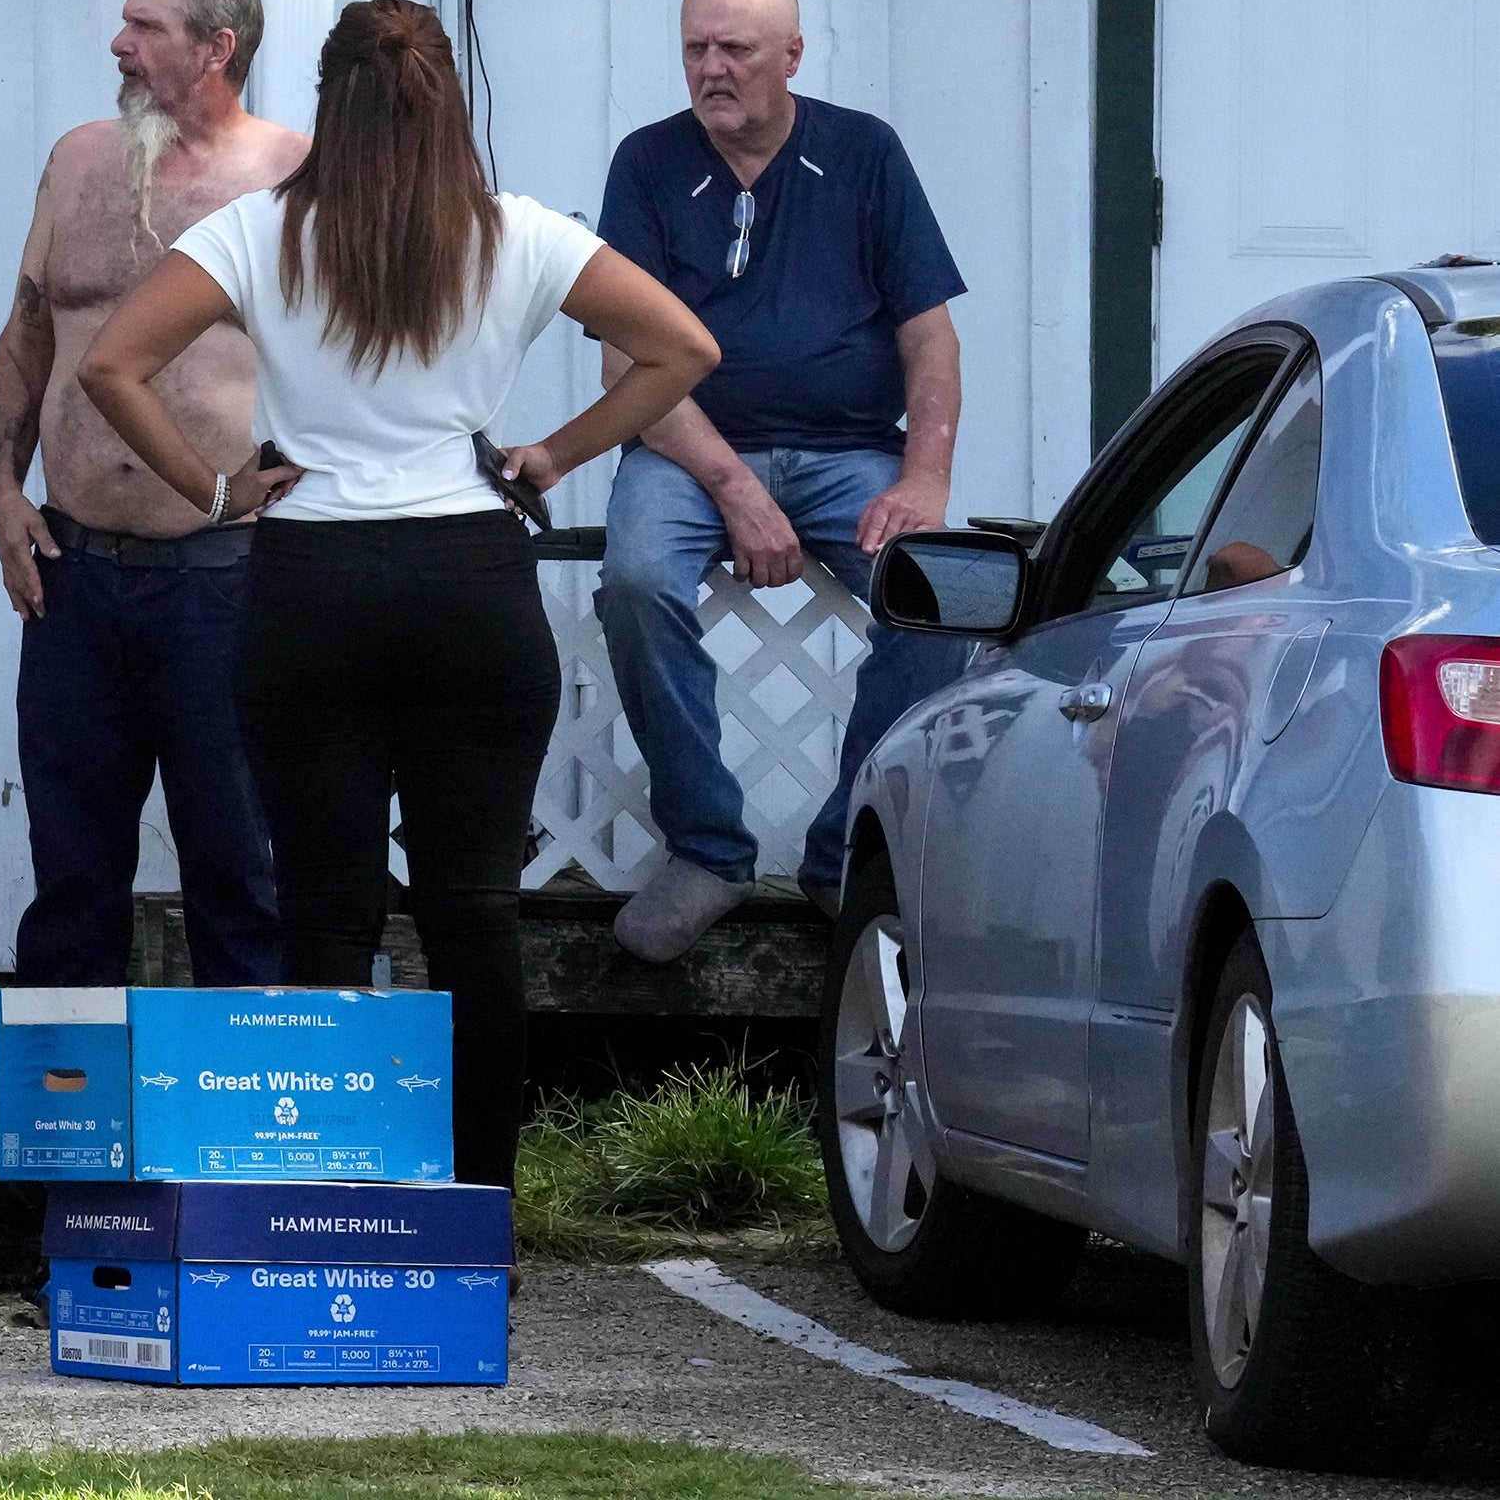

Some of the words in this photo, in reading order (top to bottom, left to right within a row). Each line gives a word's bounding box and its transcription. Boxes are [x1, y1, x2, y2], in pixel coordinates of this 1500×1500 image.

[230, 1014, 337, 1027] HAMMERMILL
[198, 1070, 262, 1091] Great
[267, 1071, 334, 1091] White
[344, 1072, 375, 1092] 30
[35, 1120, 58, 1130] Great
[58, 1120, 83, 1131] White
[85, 1120, 96, 1131] 30
[65, 1214, 152, 1231] HAMMERMILL
[270, 1216, 415, 1234] HAMMERMILL
[251, 1268, 317, 1288] Great
[324, 1268, 395, 1289] White
[404, 1270, 435, 1289] 30
[303, 1350, 316, 1359] 92
[341, 1350, 370, 1360] 5,000
